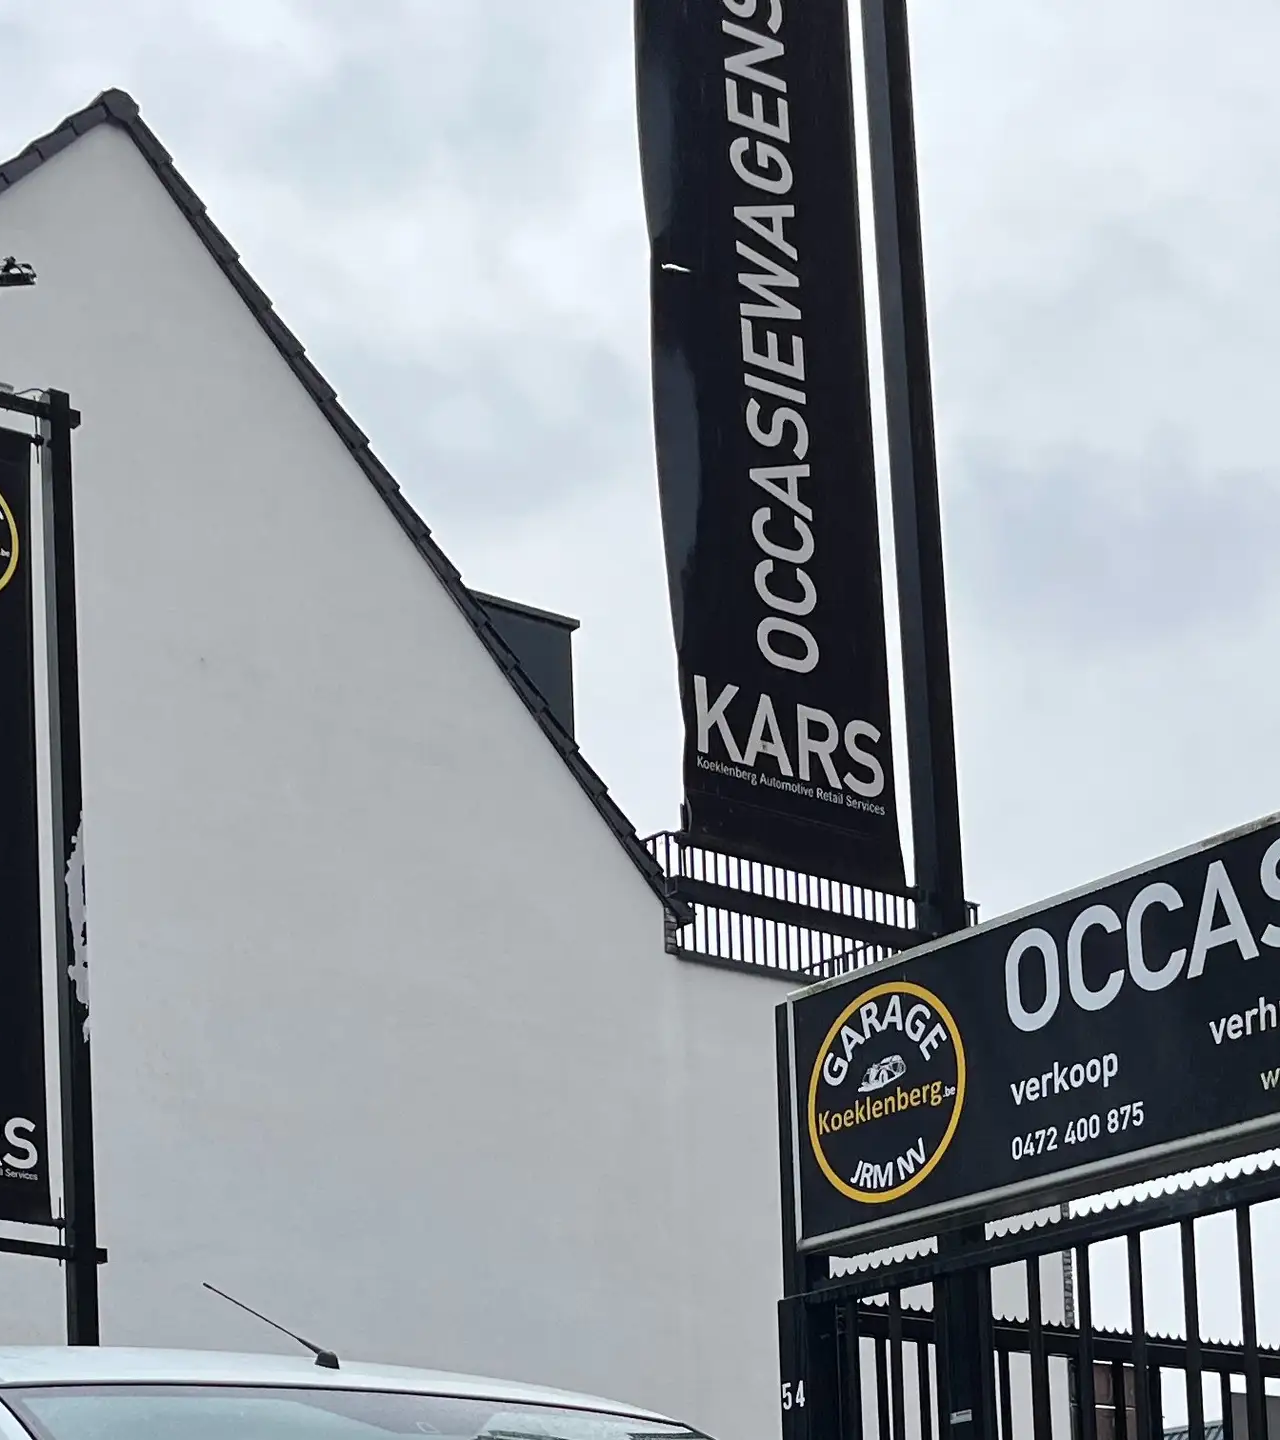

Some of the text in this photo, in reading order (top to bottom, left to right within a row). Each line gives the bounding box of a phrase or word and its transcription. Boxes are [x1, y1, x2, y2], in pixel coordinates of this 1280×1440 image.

[694, 675, 885, 798] KARS
[696, 755, 885, 816] Koeklenberg Automotive Retail Services
[823, 994, 948, 1086] GARAGE
[1010, 1053, 1118, 1106] verkoop
[1011, 1101, 1144, 1160] 0472 400 875
[850, 1137, 926, 1189] JRM NV
[782, 1380, 806, 1410] 54
